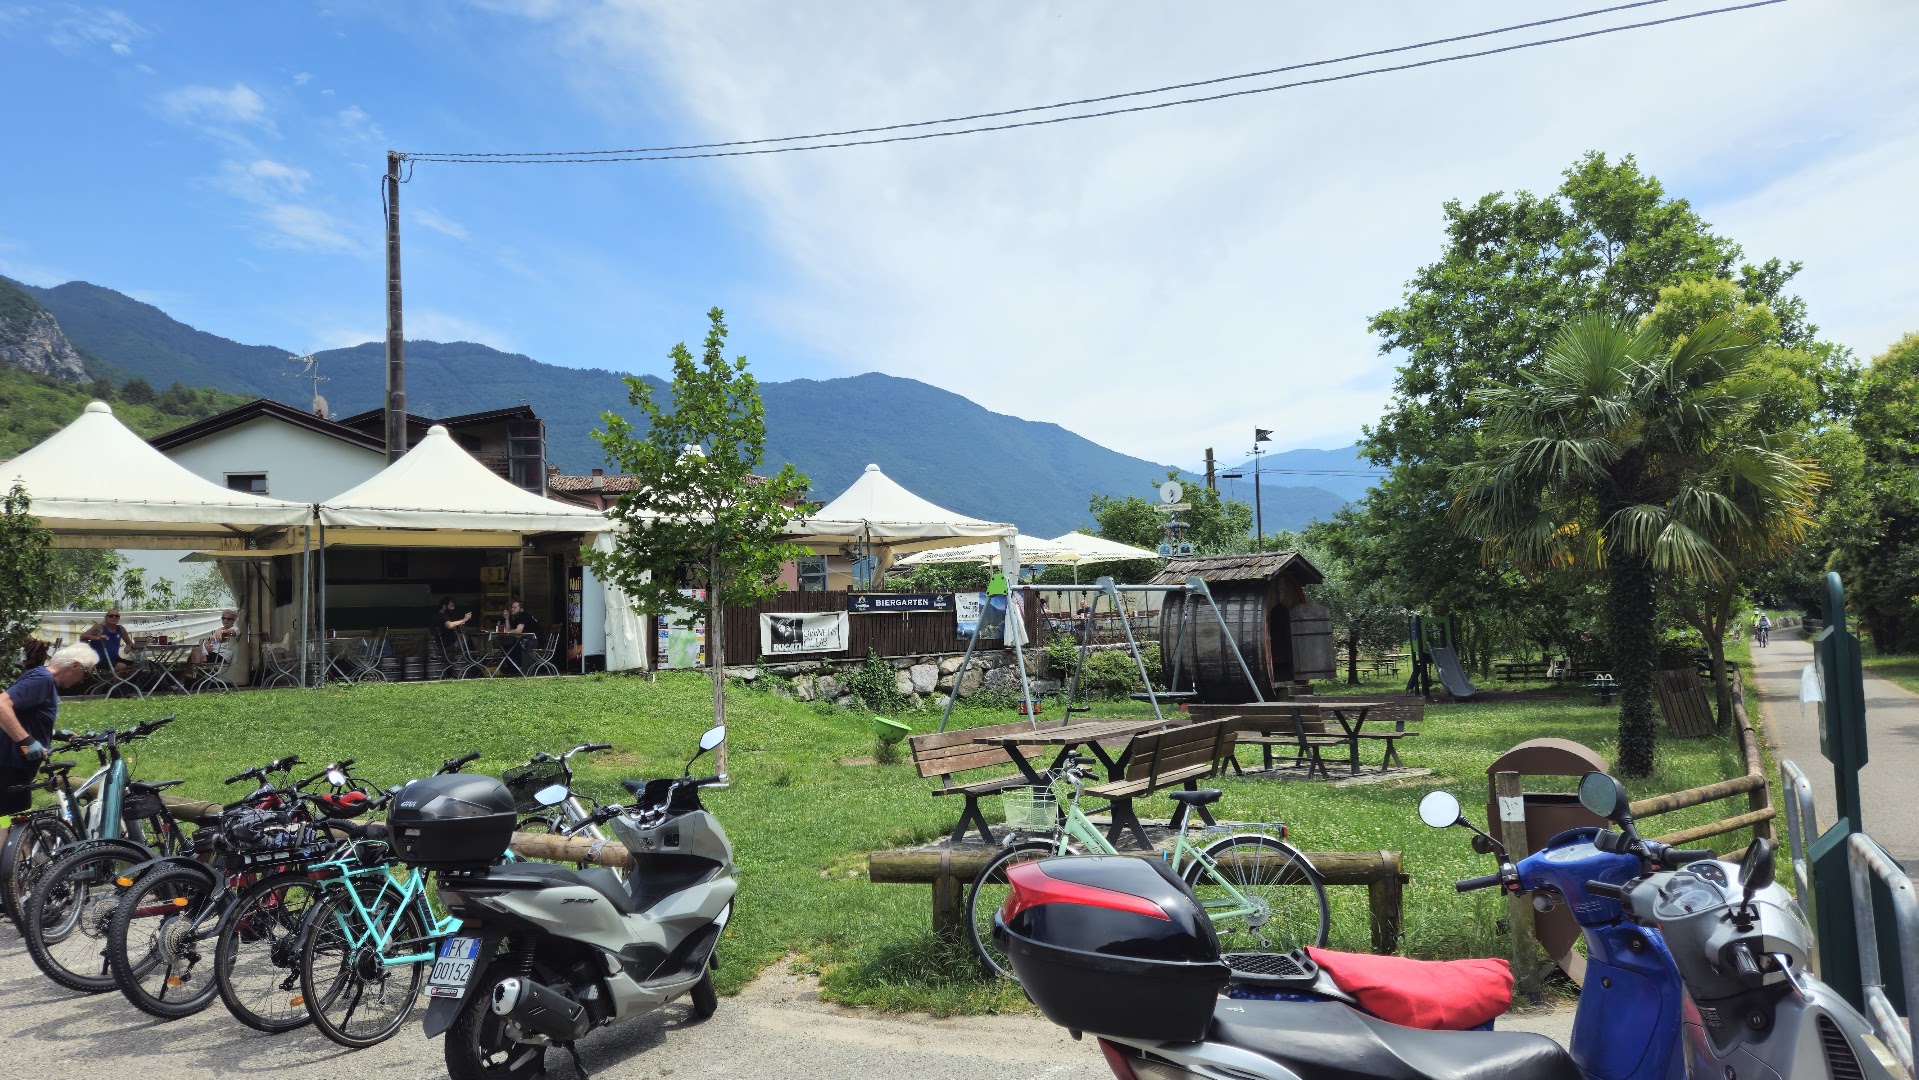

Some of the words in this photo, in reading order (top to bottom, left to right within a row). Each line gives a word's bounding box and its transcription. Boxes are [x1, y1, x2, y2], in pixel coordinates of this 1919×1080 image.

[876, 599, 929, 607] BIERGARTEN
[774, 643, 802, 652] DUCATI
[804, 638, 828, 648] CLUB
[448, 939, 466, 957] FK
[433, 962, 471, 981] 00152
